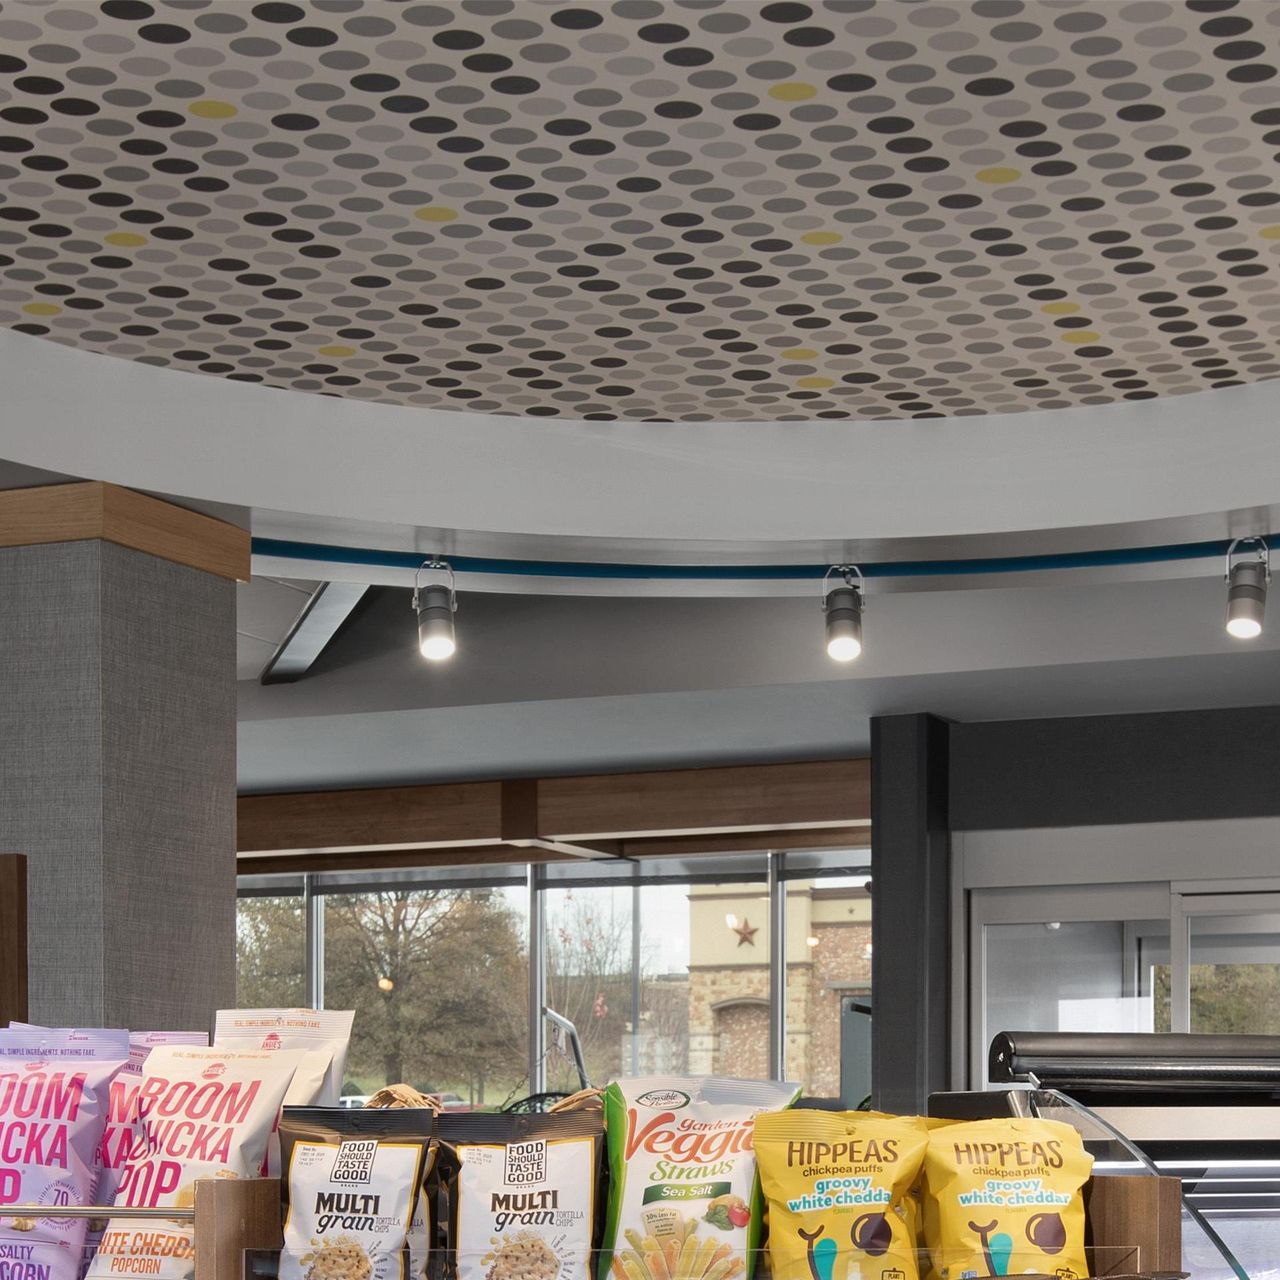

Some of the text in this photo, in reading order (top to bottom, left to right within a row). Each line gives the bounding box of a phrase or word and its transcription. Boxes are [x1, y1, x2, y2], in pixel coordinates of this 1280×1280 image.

[138, 1077, 262, 1124] BOOM
[677, 1118, 737, 1132] garden
[129, 1120, 234, 1164] CHICKA
[342, 1142, 375, 1153] FOOD
[509, 1142, 544, 1155] FOOD
[339, 1152, 372, 1160] SHOULD
[508, 1153, 544, 1163] SHOULD
[788, 1139, 899, 1167] HIPPEAS
[954, 1140, 1063, 1168] HIPPEAS
[337, 1160, 370, 1170] TASTE
[508, 1161, 543, 1173] TASTE
[649, 1159, 735, 1181] Straws
[803, 1165, 883, 1177] chickpea puffs
[334, 1170, 369, 1181] GOOD.
[508, 1171, 544, 1183] GOOD.
[973, 1167, 1050, 1178] chickpea puffs
[117, 1160, 182, 1208] POP
[661, 1185, 712, 1197] Sea Salt
[816, 1177, 870, 1195] groovy
[987, 1180, 1041, 1192] groovy
[54, 1189, 68, 1206] 70
[315, 1192, 380, 1215] MULTI
[491, 1190, 558, 1212] MULTI
[789, 1189, 891, 1211] white chedda
[960, 1191, 1069, 1205] white cheddar
[316, 1214, 375, 1235] grain
[376, 1217, 401, 1226] TORTILLA
[494, 1211, 555, 1232] grain
[374, 1225, 389, 1233] CHIPS
[0, 1245, 34, 1260] SALTY
[130, 1233, 195, 1260] CHEDDA
[111, 1257, 161, 1274] POPCORN
